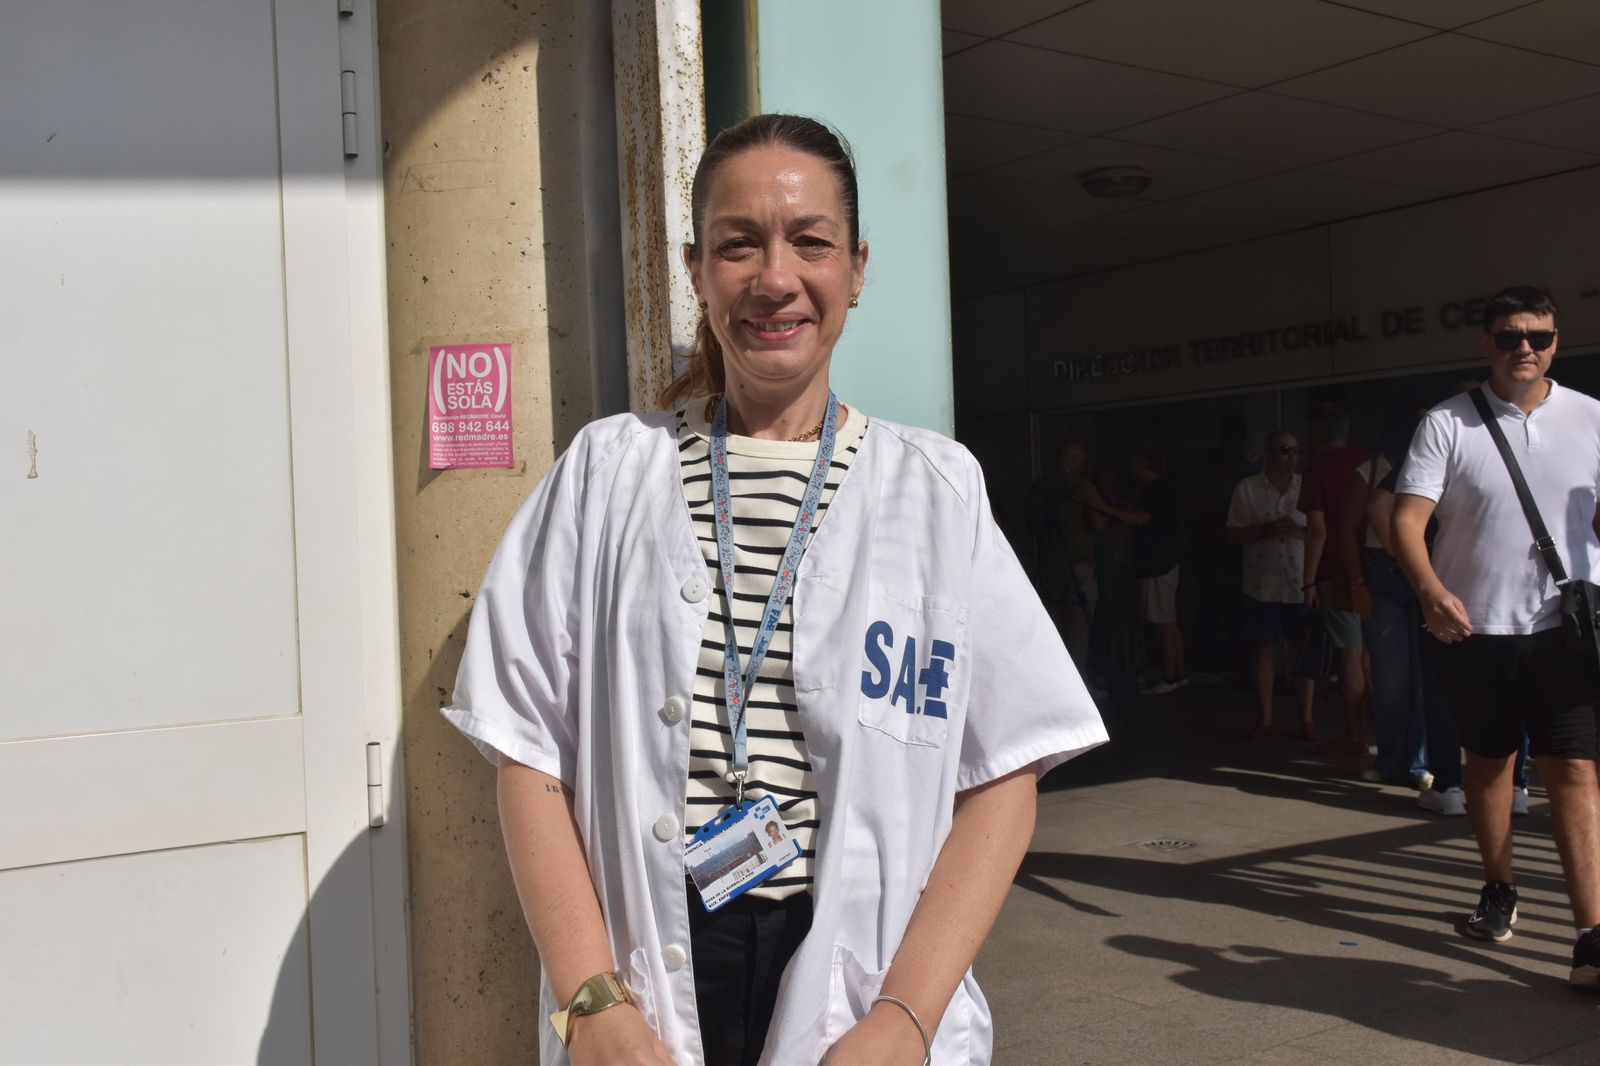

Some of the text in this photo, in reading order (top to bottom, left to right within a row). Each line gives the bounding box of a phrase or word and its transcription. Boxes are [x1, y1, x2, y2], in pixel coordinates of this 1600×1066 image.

[1188, 315, 1370, 364] TERRITORIAL
[1381, 306, 1425, 336] DE
[447, 379, 493, 396] ESTÁS
[447, 395, 492, 410] SOLA
[432, 420, 510, 433] 698 942 644
[433, 433, 509, 442] www.redmadre.es
